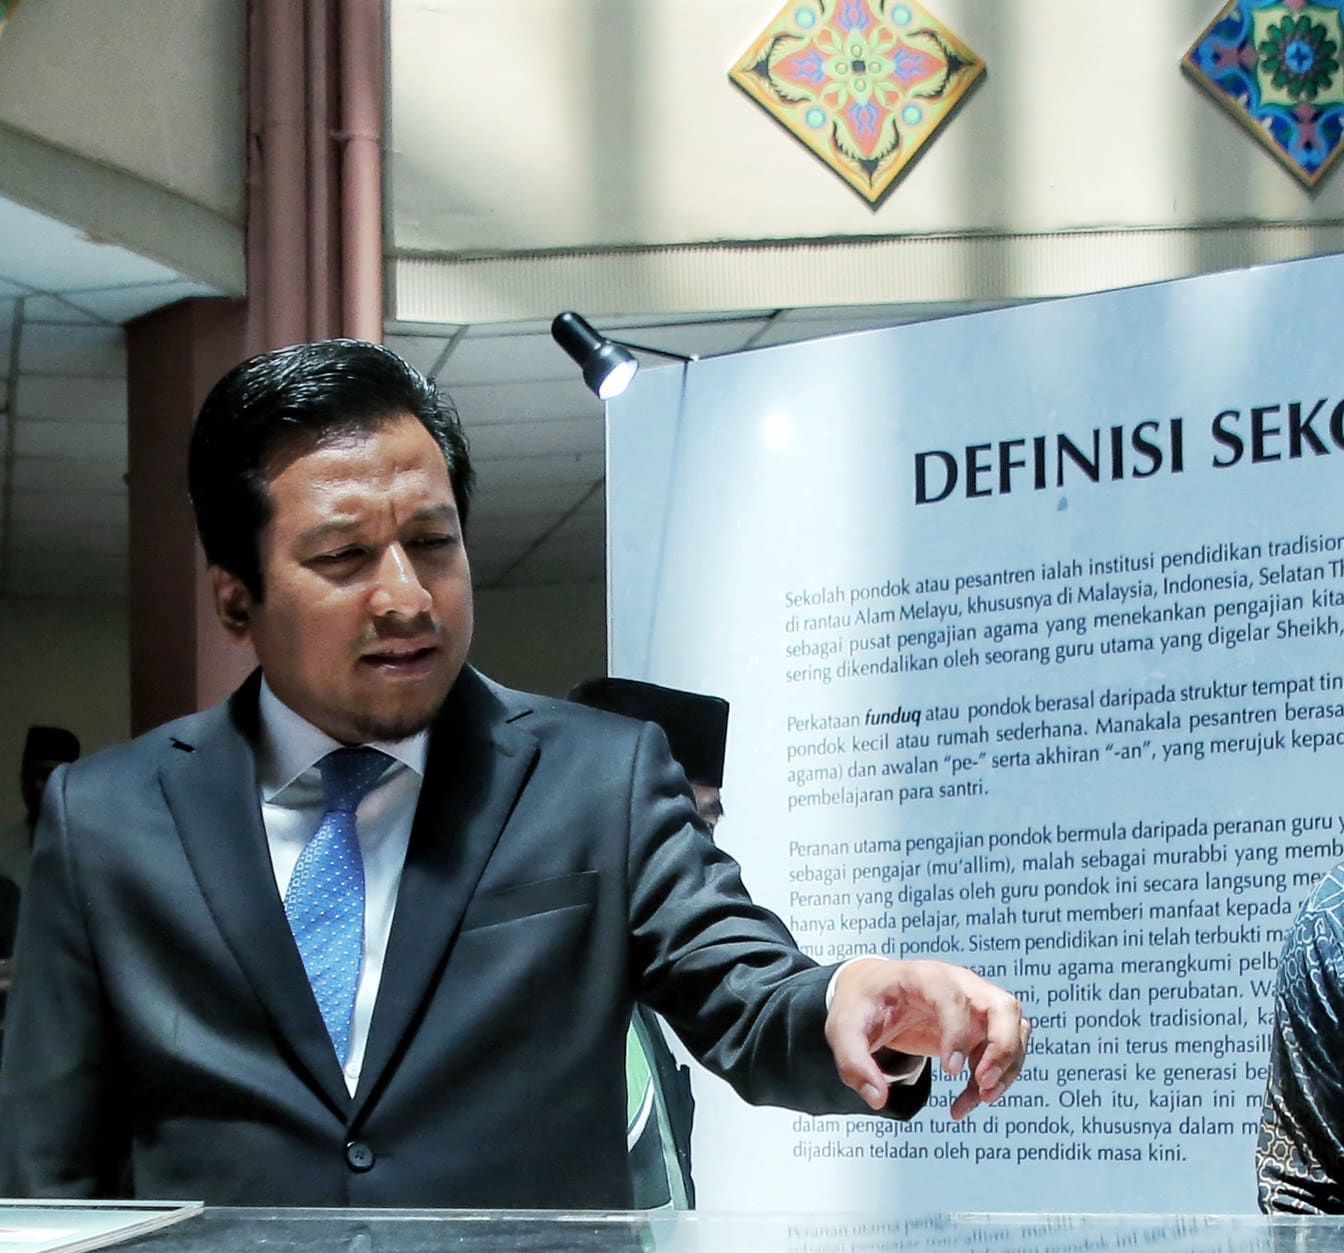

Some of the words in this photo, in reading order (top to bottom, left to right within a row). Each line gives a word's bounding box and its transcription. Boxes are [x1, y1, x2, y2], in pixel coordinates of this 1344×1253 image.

[914, 416, 1185, 506] DEFINISI
[956, 566, 1035, 595] pesantren
[1042, 556, 1082, 580] ialah
[1090, 551, 1153, 575] institusi
[1161, 540, 1261, 574] pendidikan
[900, 598, 962, 623] Melayu,
[968, 592, 1052, 614] khususnya
[1078, 579, 1157, 605] Malaysia,
[1164, 570, 1253, 595] Indonesia,
[1260, 562, 1324, 585] Selatan
[898, 623, 976, 652] pengajian
[984, 619, 1038, 644] agama
[1094, 600, 1205, 628] menekankan
[1214, 593, 1303, 623] pengajian
[969, 693, 1031, 724] pondok
[1036, 688, 1094, 713] berasal
[1100, 683, 1175, 711] daripada
[1181, 678, 1247, 701] struktur
[1253, 673, 1314, 699] tempat
[882, 753, 938, 776] awalan
[992, 748, 1030, 768] serta
[1036, 743, 1099, 765] akhiran
[1211, 728, 1284, 756] merujuk
[1023, 848, 1074, 870] malah
[1082, 847, 1145, 872] sebagai
[1154, 842, 1226, 865] murabbi
[900, 932, 964, 959] pondok.
[969, 931, 1020, 951] Sistem
[1026, 927, 1117, 956] pendidikan
[1149, 925, 1190, 946] telah
[1195, 923, 1260, 944] terbukti
[1076, 1006, 1141, 1034] pondok
[1150, 1005, 1247, 1029] tradisional,
[930, 1113, 976, 1133] turath
[1006, 1113, 1074, 1139] pondok,
[1082, 1113, 1171, 1140] khususnya
[1179, 1114, 1235, 1134] dalam
[1017, 1139, 1091, 1165] pendidik
[1149, 1140, 1186, 1161] kini.
